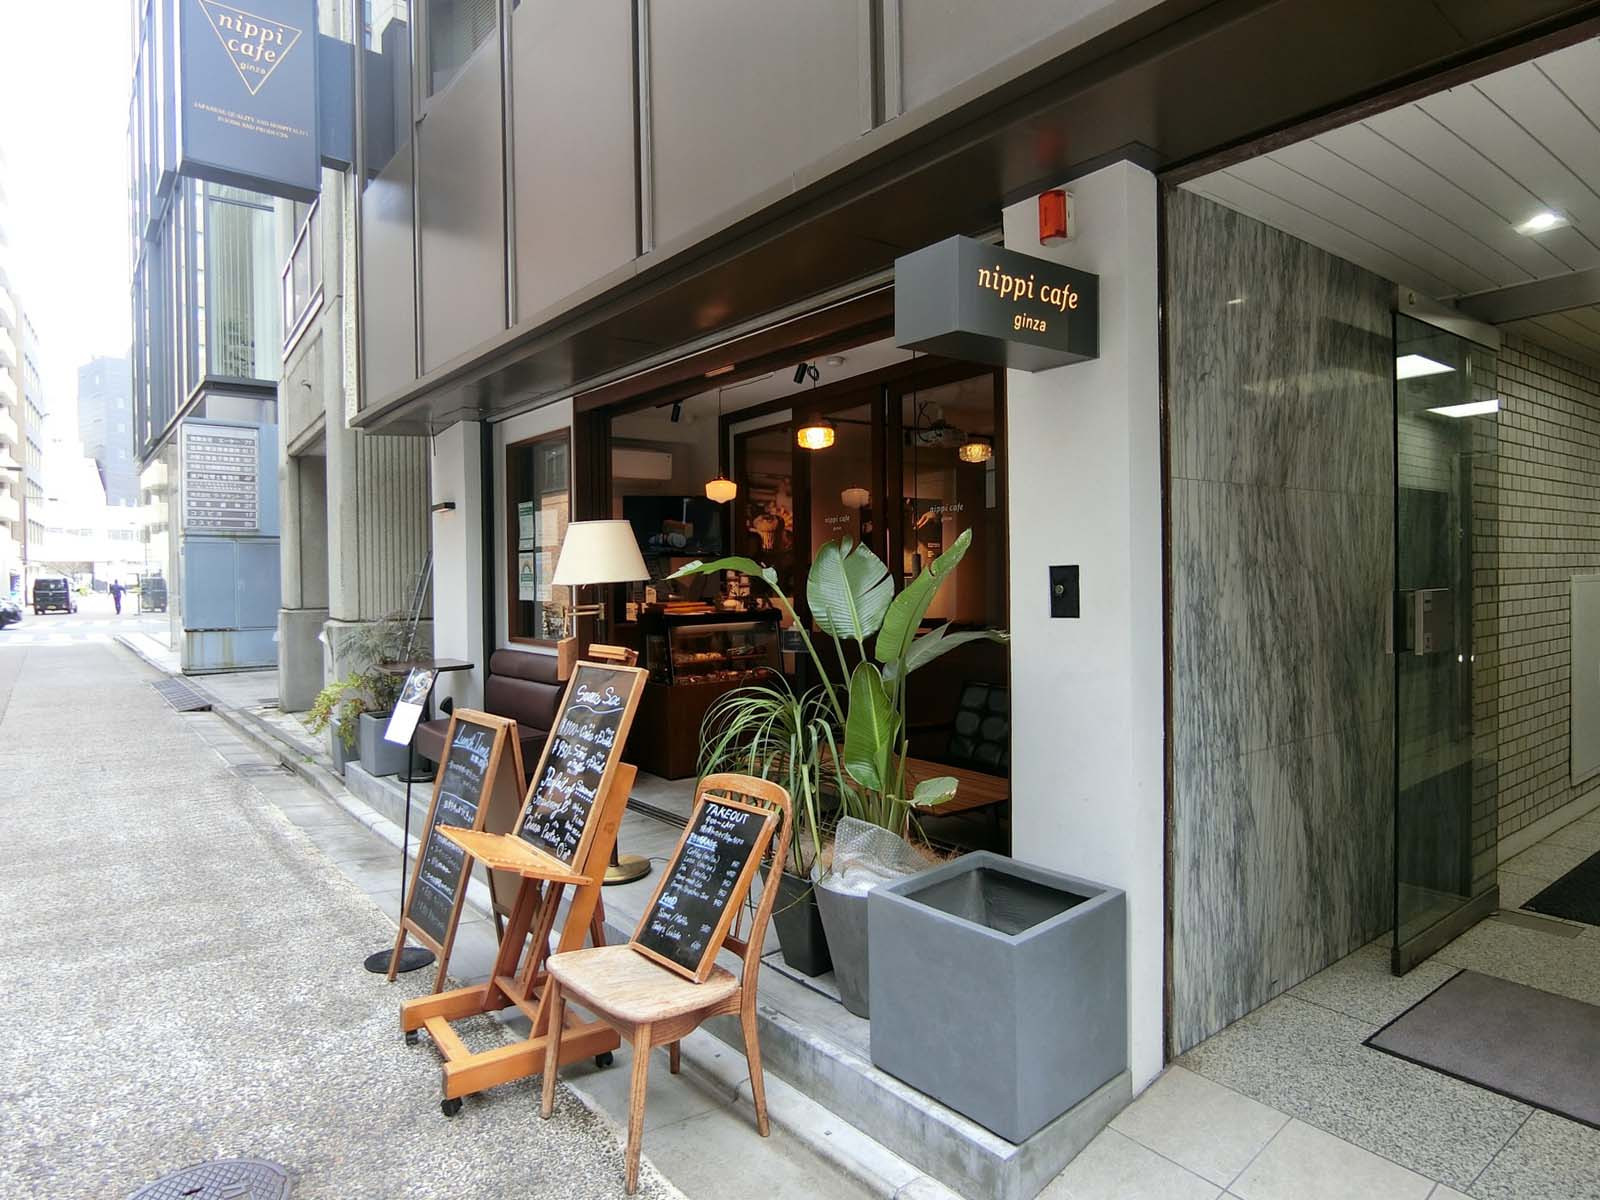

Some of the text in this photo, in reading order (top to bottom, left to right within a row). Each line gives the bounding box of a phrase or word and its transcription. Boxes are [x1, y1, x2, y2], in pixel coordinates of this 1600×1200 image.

[218, 14, 284, 46] nippi
[227, 38, 277, 63] cafe
[239, 61, 266, 75] ginza
[978, 265, 1079, 312] nippi cafe
[1013, 313, 1047, 332] ginza
[949, 502, 965, 513] cafe
[706, 803, 750, 825] TAKEOUT
